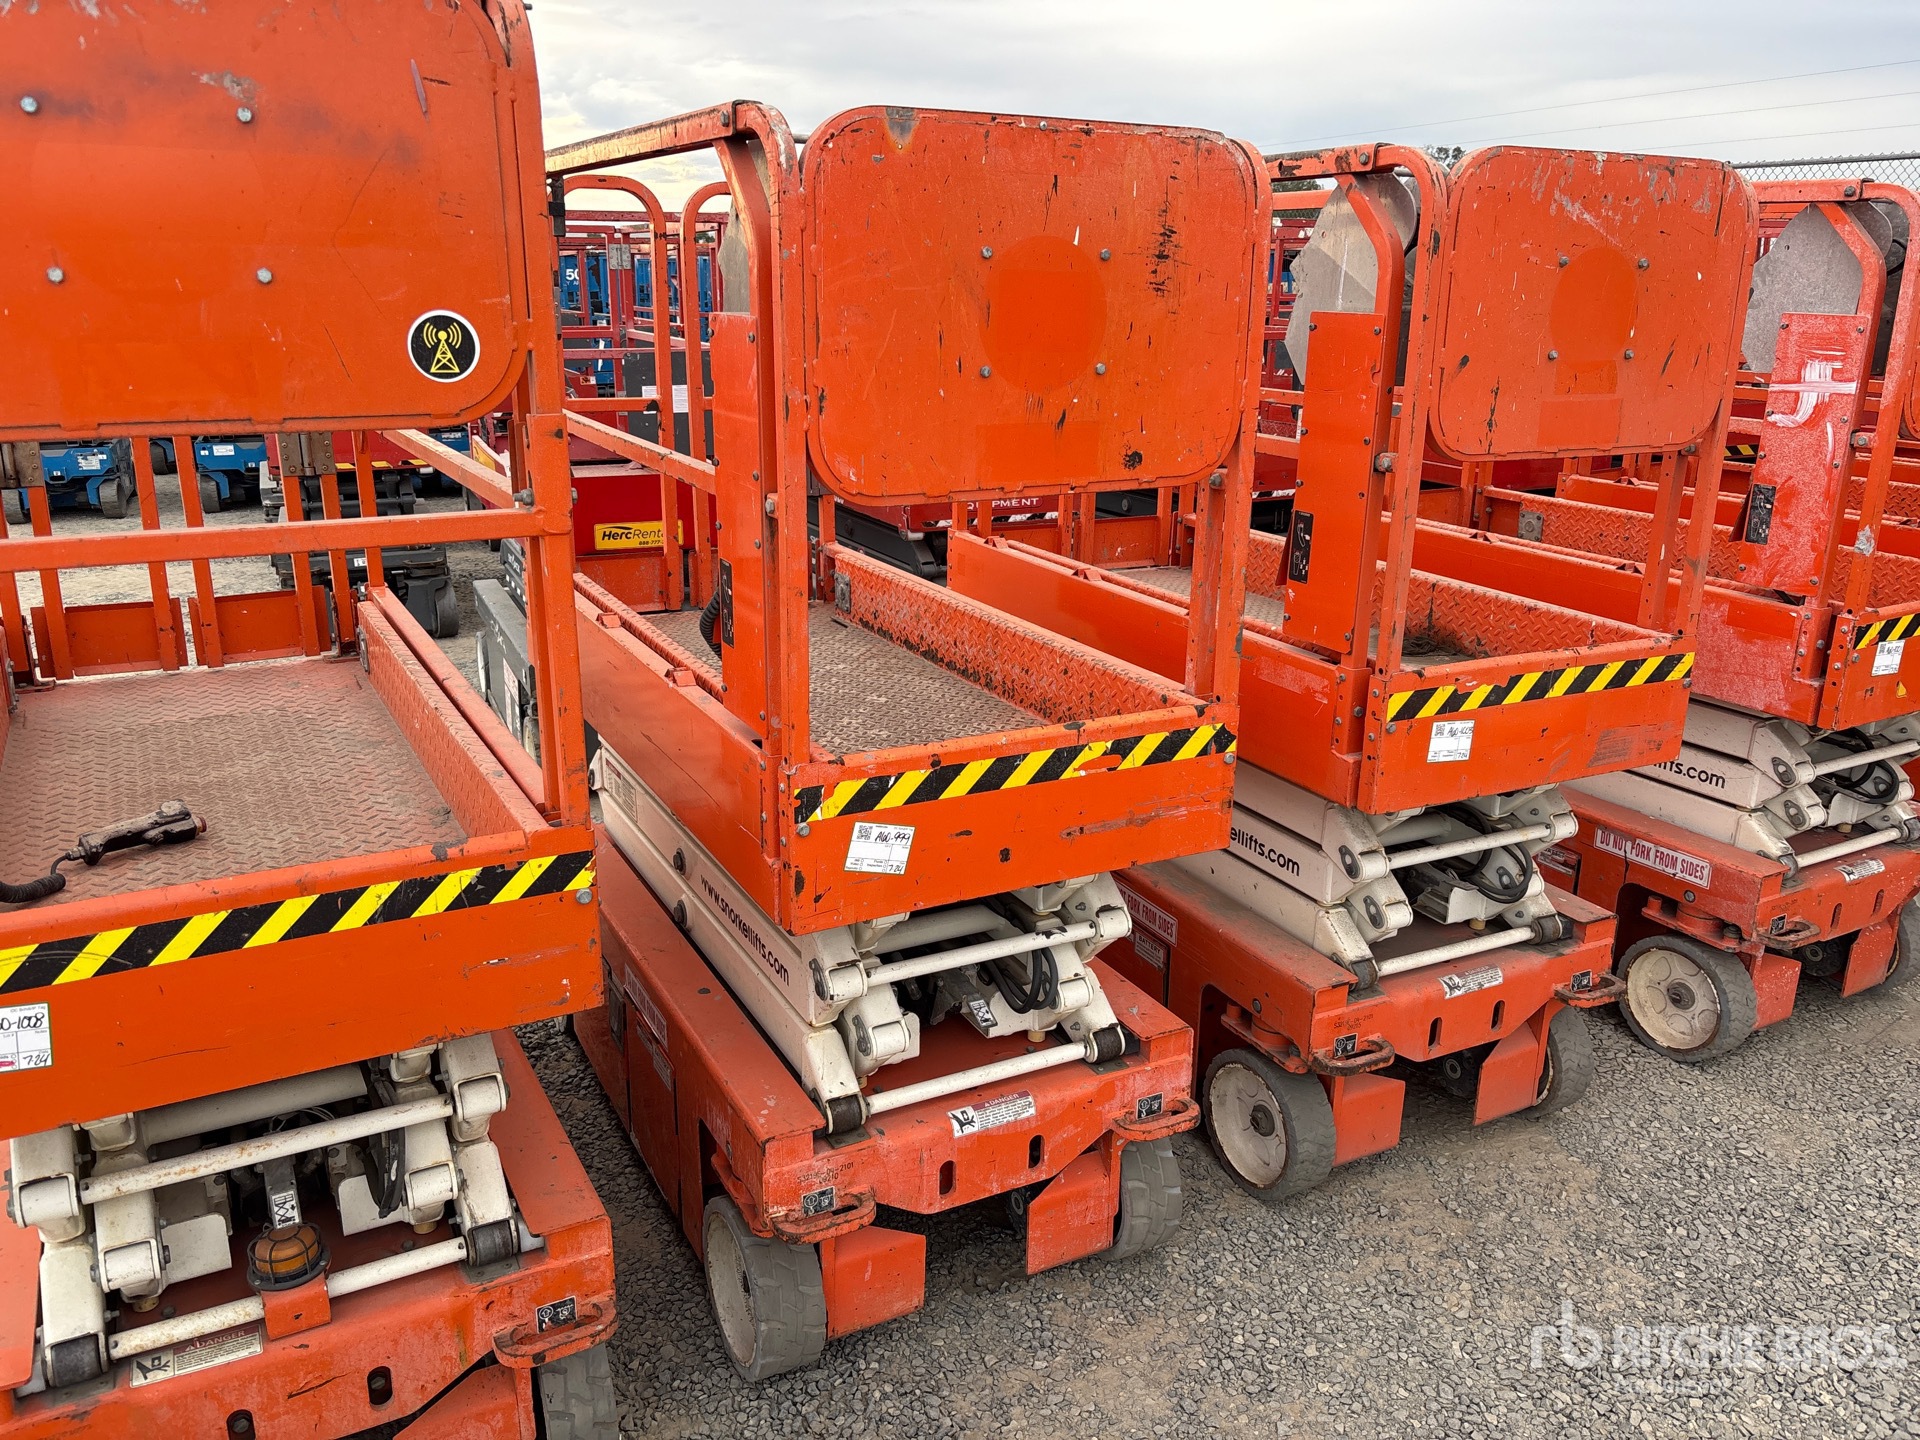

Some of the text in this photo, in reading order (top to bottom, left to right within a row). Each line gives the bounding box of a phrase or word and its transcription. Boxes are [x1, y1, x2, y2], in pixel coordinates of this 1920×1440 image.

[1630, 841, 1652, 862] FORK
[1654, 849, 1678, 871] FROM
[1680, 859, 1705, 881] SIDES
[701, 874, 790, 987] www.snorkellifts.com
[1158, 914, 1174, 938] SIDES
[990, 1093, 1019, 1105] DANGER
[195, 1330, 246, 1348] DANGER
